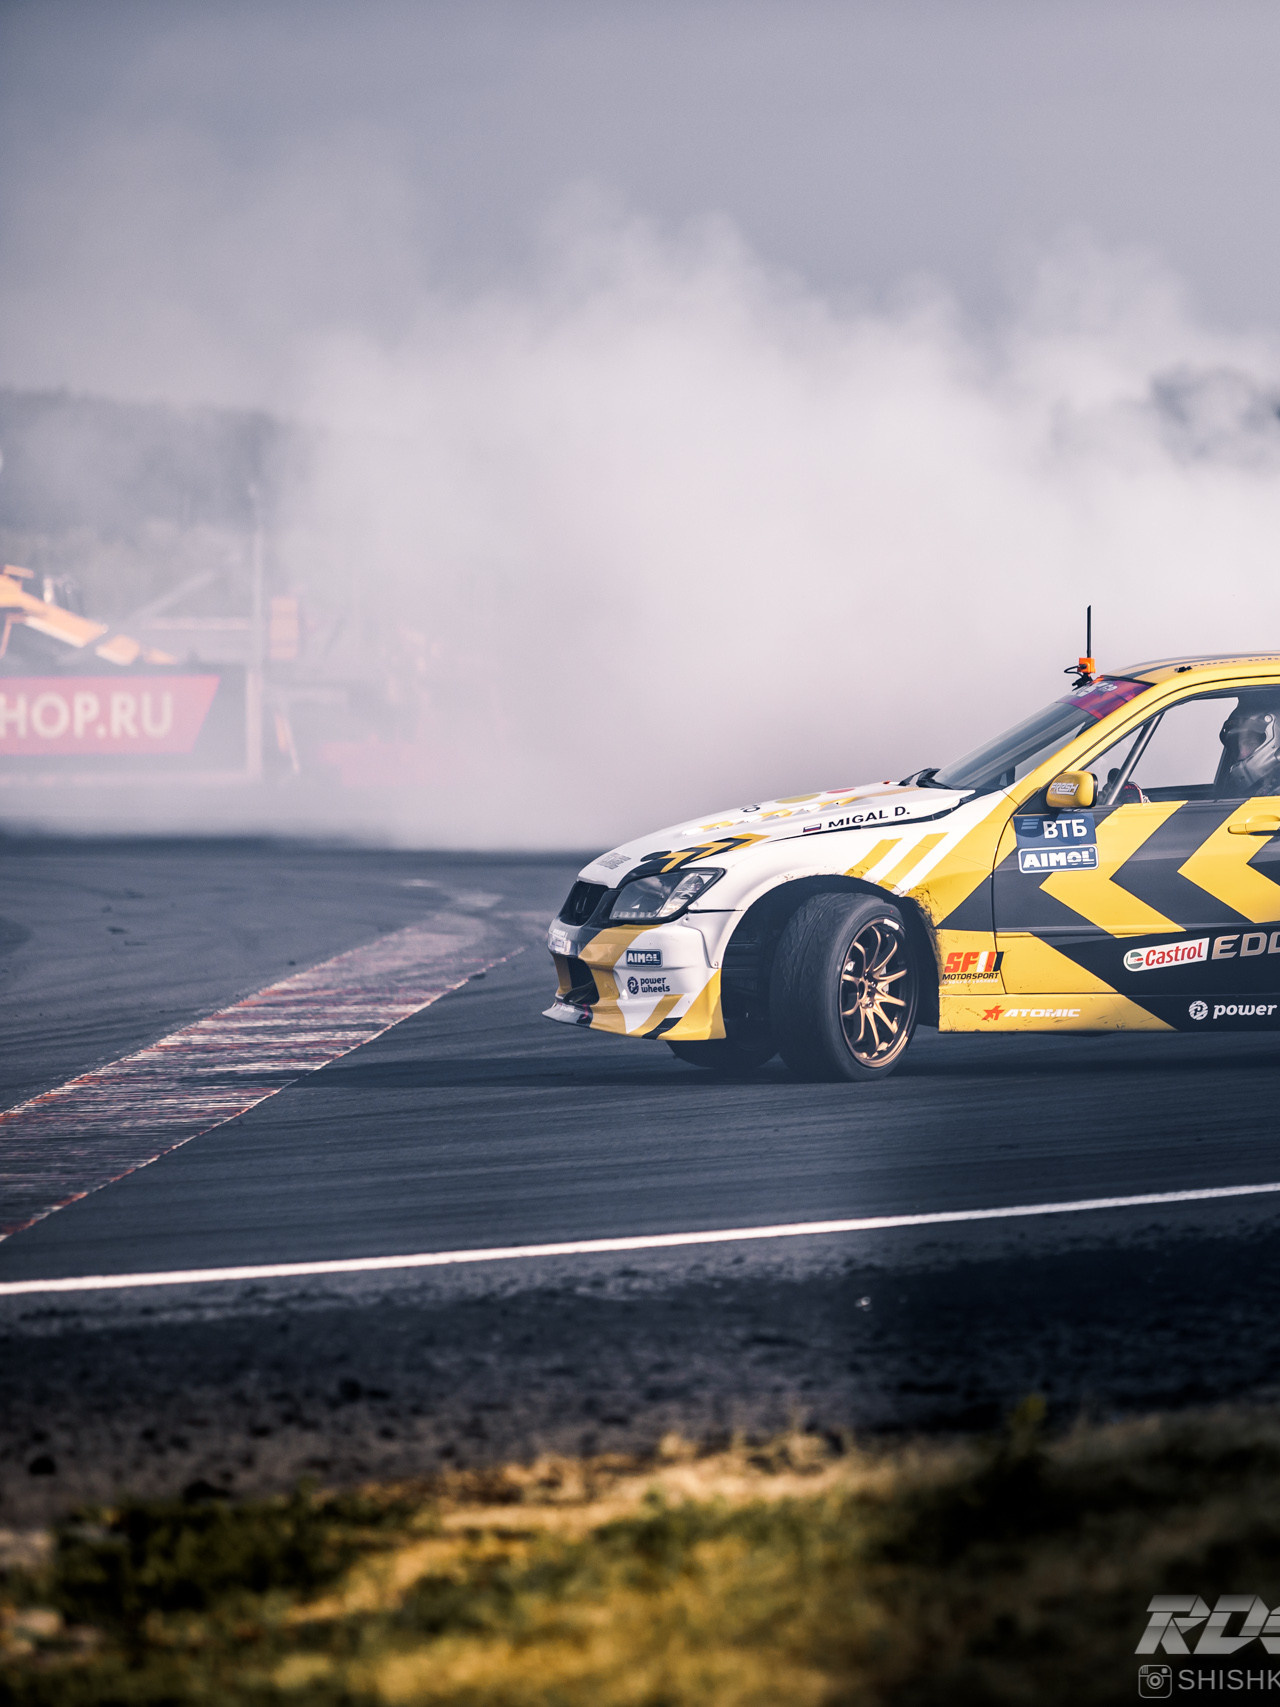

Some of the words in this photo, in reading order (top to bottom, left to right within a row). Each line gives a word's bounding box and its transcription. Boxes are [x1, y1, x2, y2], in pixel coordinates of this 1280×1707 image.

[828, 810, 888, 828] MIGAL
[894, 806, 911, 816] D.
[1043, 819, 1088, 839] ВТБ
[1022, 850, 1095, 868] AIMOL
[627, 951, 661, 964] AIMOL
[1145, 942, 1203, 967] Castrol
[640, 977, 667, 987] power
[942, 972, 999, 981] MOTORSPORT
[641, 984, 671, 993] wheels
[1003, 1008, 1081, 1018] ATOMIC
[1212, 1003, 1278, 1020] power
